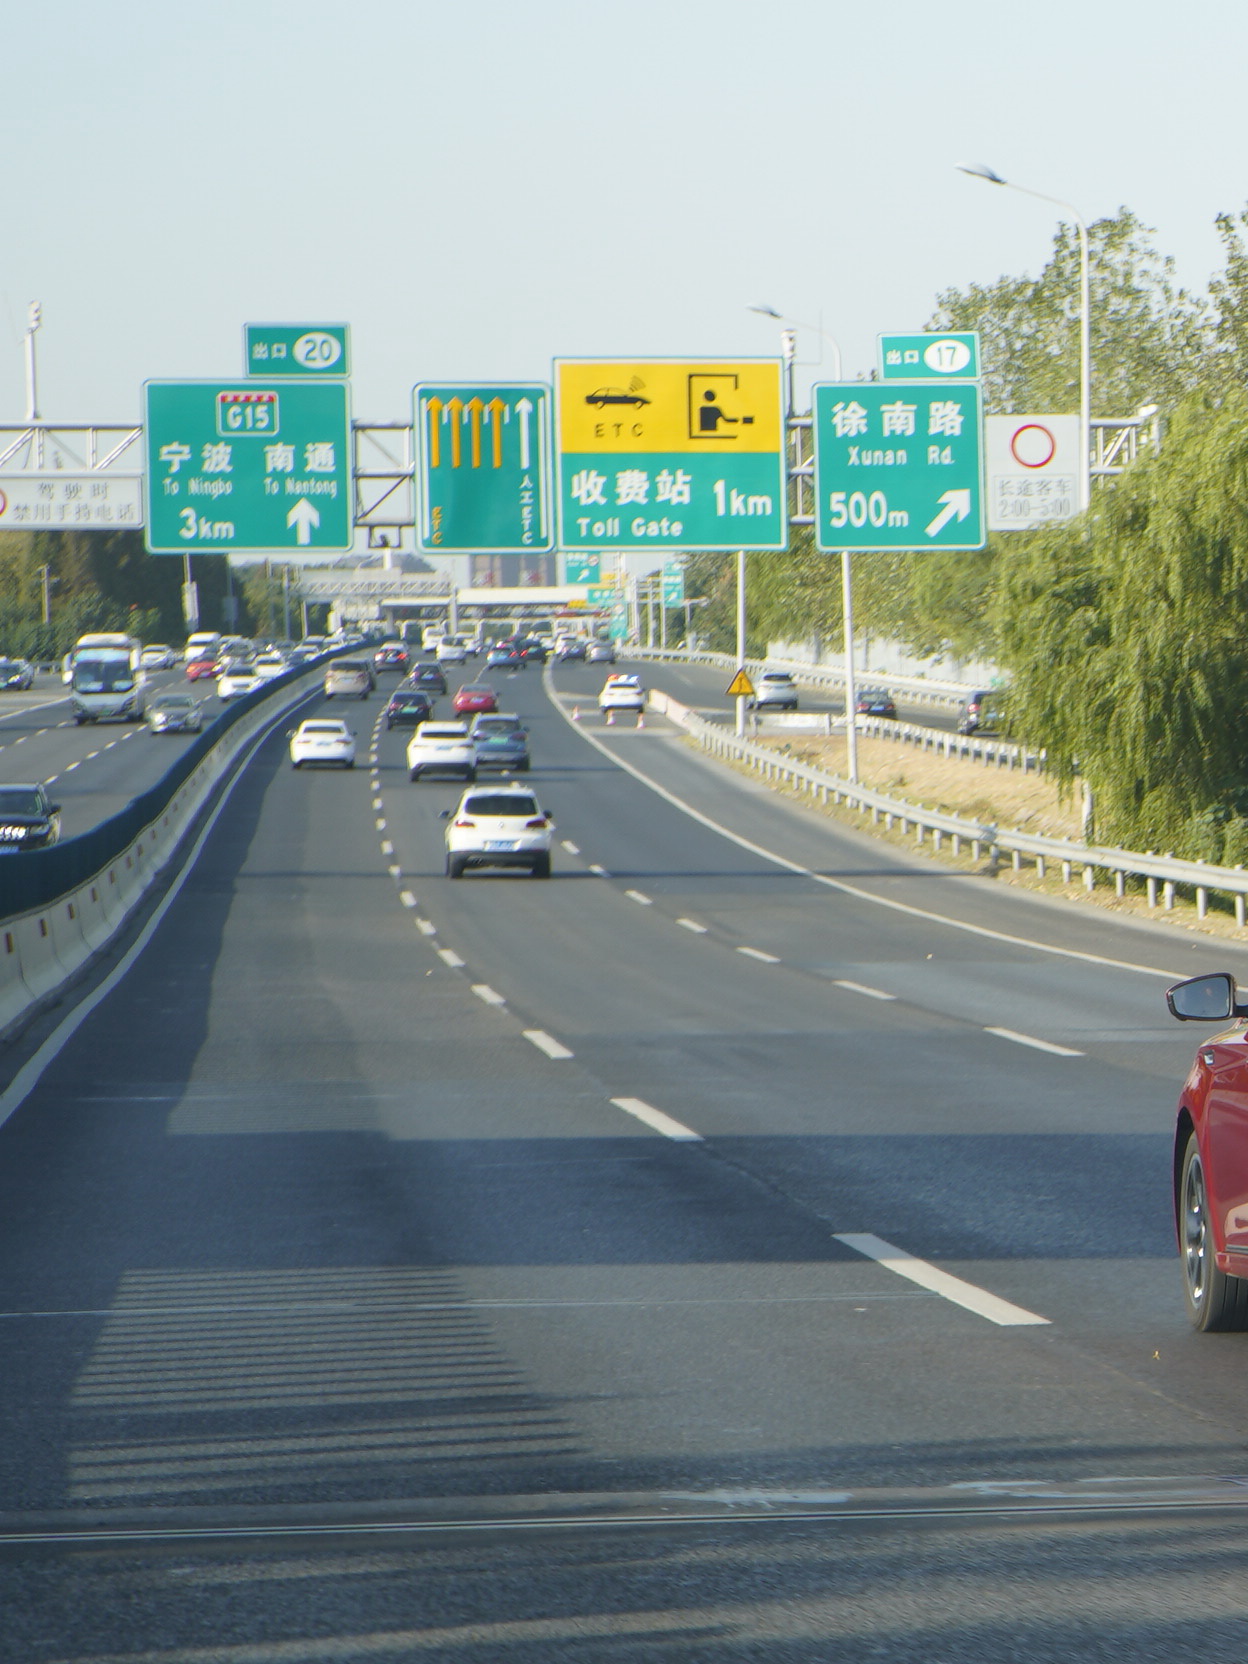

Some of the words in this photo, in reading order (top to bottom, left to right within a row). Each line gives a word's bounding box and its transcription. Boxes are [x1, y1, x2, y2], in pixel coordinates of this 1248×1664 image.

[252, 341, 287, 360] 出口
[304, 338, 332, 362] 20
[886, 349, 919, 365] 出口
[936, 345, 957, 367] 17
[226, 404, 271, 430] G15
[594, 422, 645, 438] ETC
[831, 400, 965, 438] 徐南路
[158, 441, 233, 474] 宁波
[263, 441, 337, 474] 南通
[847, 445, 908, 466] Xunan
[162, 477, 180, 496] To
[188, 477, 234, 500] Ningbo
[263, 477, 280, 496] To
[285, 477, 338, 500] Nantong
[570, 468, 693, 507] 收费站
[712, 478, 773, 517] 1km
[829, 489, 909, 529] 500m
[179, 507, 235, 540] 3km
[431, 506, 443, 545] ETC
[576, 517, 620, 538] Toll
[631, 517, 683, 538] Gate
